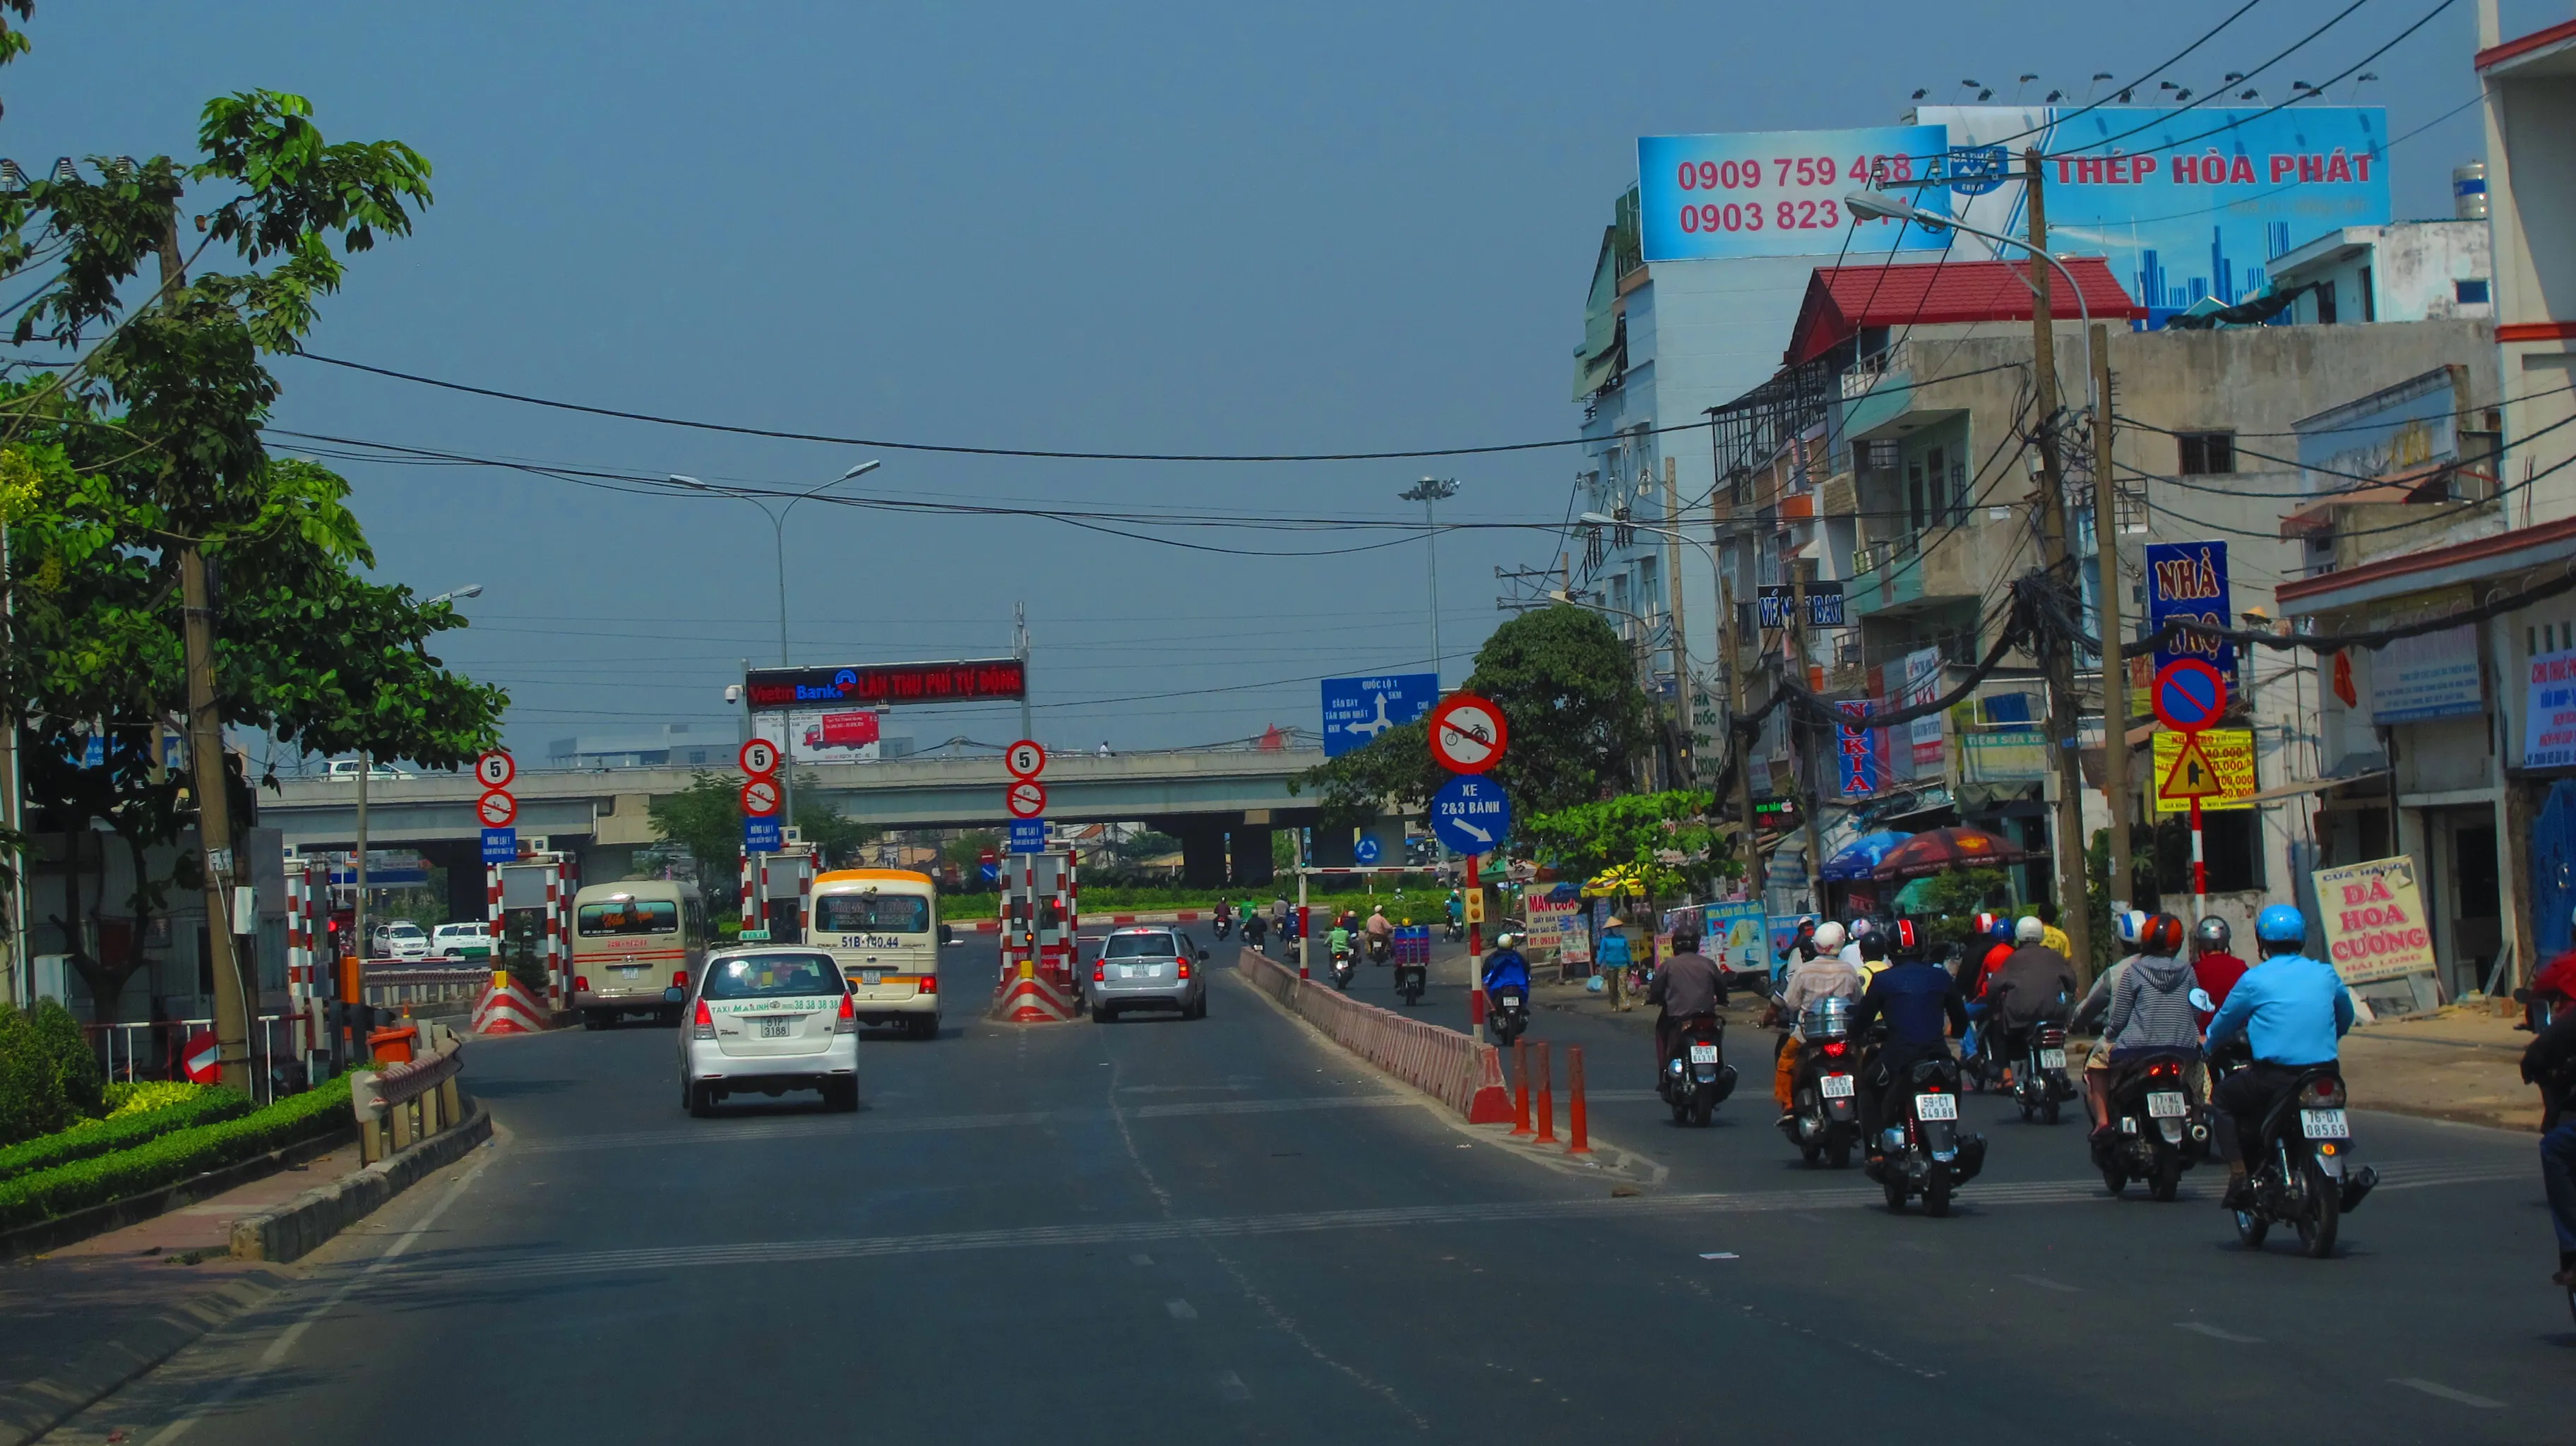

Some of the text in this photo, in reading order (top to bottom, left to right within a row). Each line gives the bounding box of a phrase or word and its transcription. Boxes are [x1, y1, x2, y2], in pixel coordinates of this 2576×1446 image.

[1678, 160, 1761, 190] 0909
[1773, 157, 1836, 187] 759
[2056, 147, 2373, 184] THÉP HÒA PHÁT
[1680, 203, 1764, 233] 0903
[1777, 199, 1839, 230] 823
[2155, 546, 2220, 600] NHÀ
[1759, 588, 1779, 626] VÉ
[1813, 594, 1843, 623] BAY
[2163, 611, 2222, 660] TRỌ
[749, 682, 837, 703] VietinBank
[893, 674, 921, 695] THU
[925, 667, 951, 694] PHÍ
[979, 668, 1020, 696] ĐỘNG
[1362, 679, 1381, 691] QUỐC
[1383, 679, 1391, 690] LỘ
[1332, 698, 1358, 708] SÂN BAY
[1325, 710, 1337, 720] TÂN
[754, 750, 765, 766] 5
[1019, 751, 1030, 768] 5
[490, 761, 501, 777] 5
[1462, 784, 1478, 796] XE
[1441, 798, 1500, 815] 2&3 BÁNH
[2339, 904, 2409, 933] HOA
[2332, 928, 2429, 964] CƯƠNG
[2380, 954, 2422, 966] LONG
[712, 1005, 731, 1014] TAXI
[794, 1000, 804, 1010] 38
[806, 1000, 816, 1009] 38
[818, 1000, 827, 1009] 38
[829, 1000, 839, 1009] 38
[765, 1027, 787, 1036] 3188
[1922, 1097, 1950, 1108] 59-C1
[1921, 1107, 1955, 1119] 549.88
[2306, 1124, 2347, 1136] 085.69
